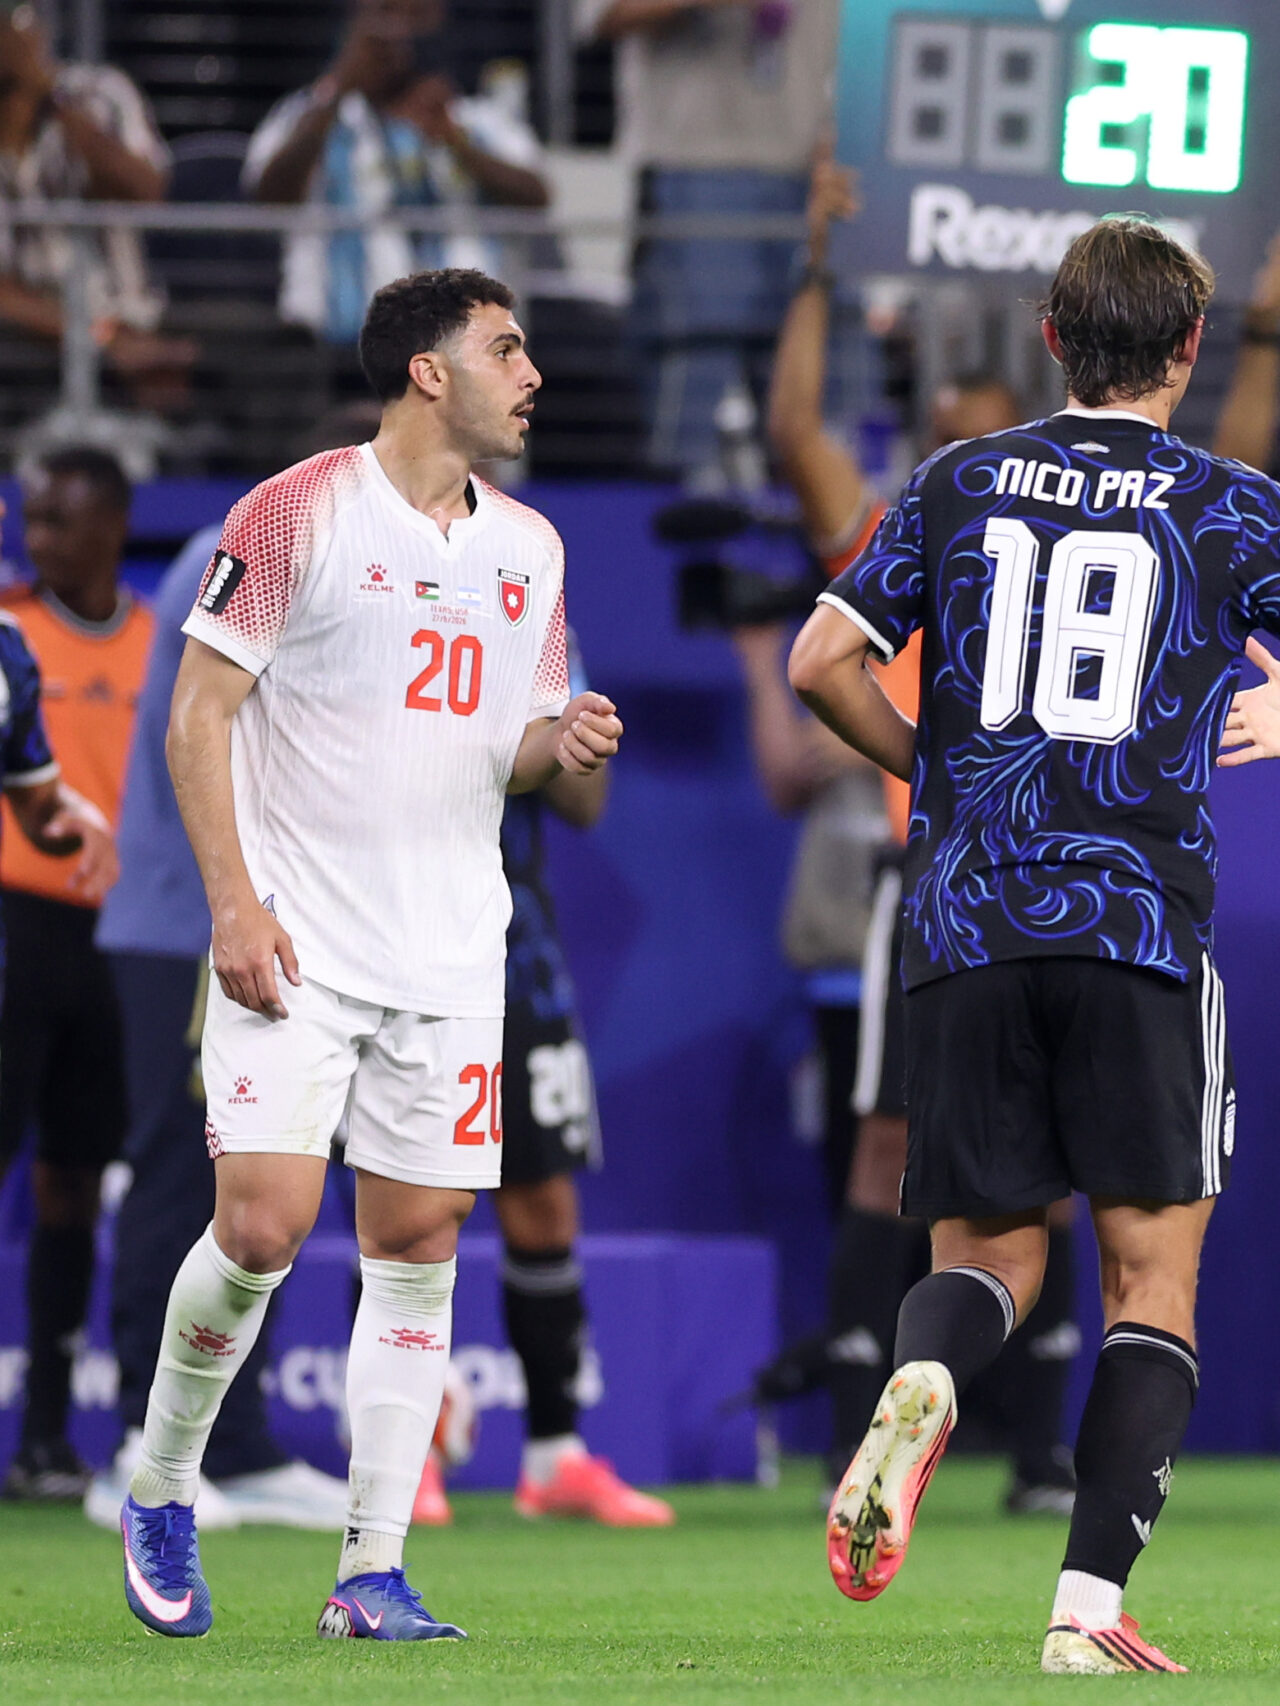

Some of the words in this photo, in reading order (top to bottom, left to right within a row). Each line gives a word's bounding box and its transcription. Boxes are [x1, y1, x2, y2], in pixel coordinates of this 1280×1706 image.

[1062, 22, 1249, 193] 20
[995, 457, 1086, 507] NICO
[1093, 470, 1176, 510] PAZ
[359, 583, 395, 593] KELME
[980, 516, 1161, 746] 18
[405, 628, 483, 717] 20
[228, 1096, 258, 1104] KELME
[178, 1328, 238, 1357] KELME
[378, 1335, 445, 1351] KELME
